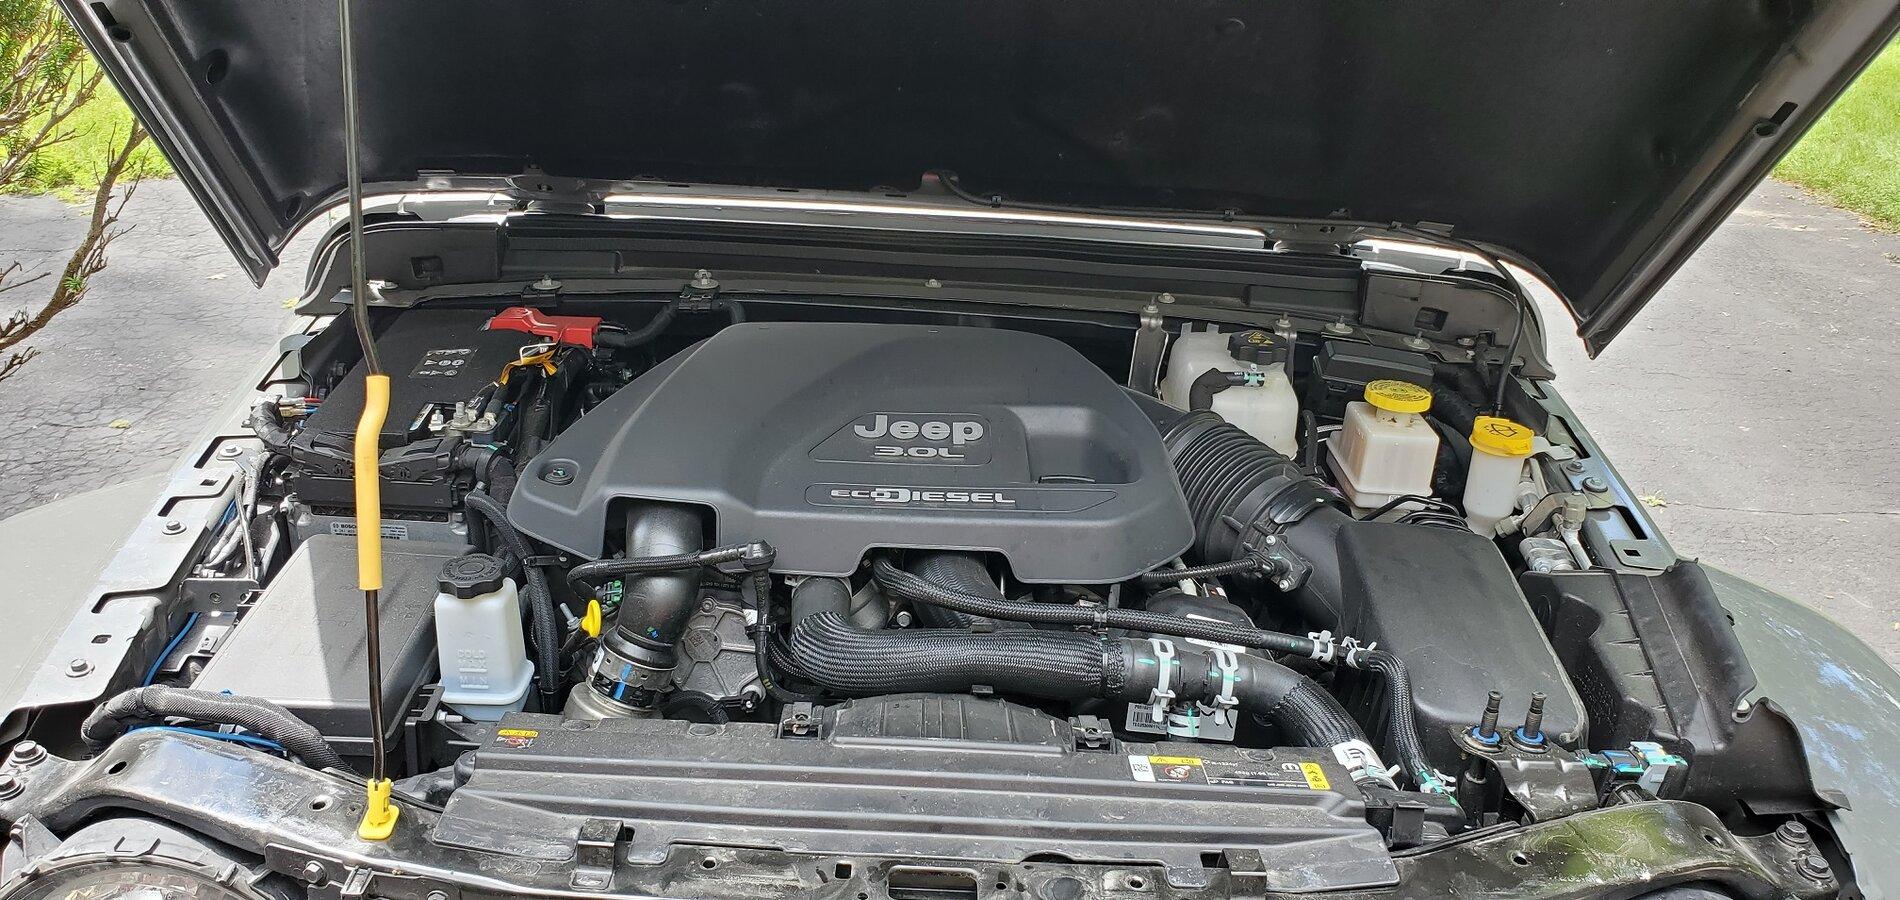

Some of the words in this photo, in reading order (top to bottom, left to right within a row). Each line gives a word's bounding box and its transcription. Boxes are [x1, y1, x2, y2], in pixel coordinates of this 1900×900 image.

[853, 414, 984, 446] Jeep
[874, 445, 965, 458] 3.0L
[458, 649, 486, 659] COLD
[458, 659, 487, 668] MAX
[459, 675, 488, 685] MIN
